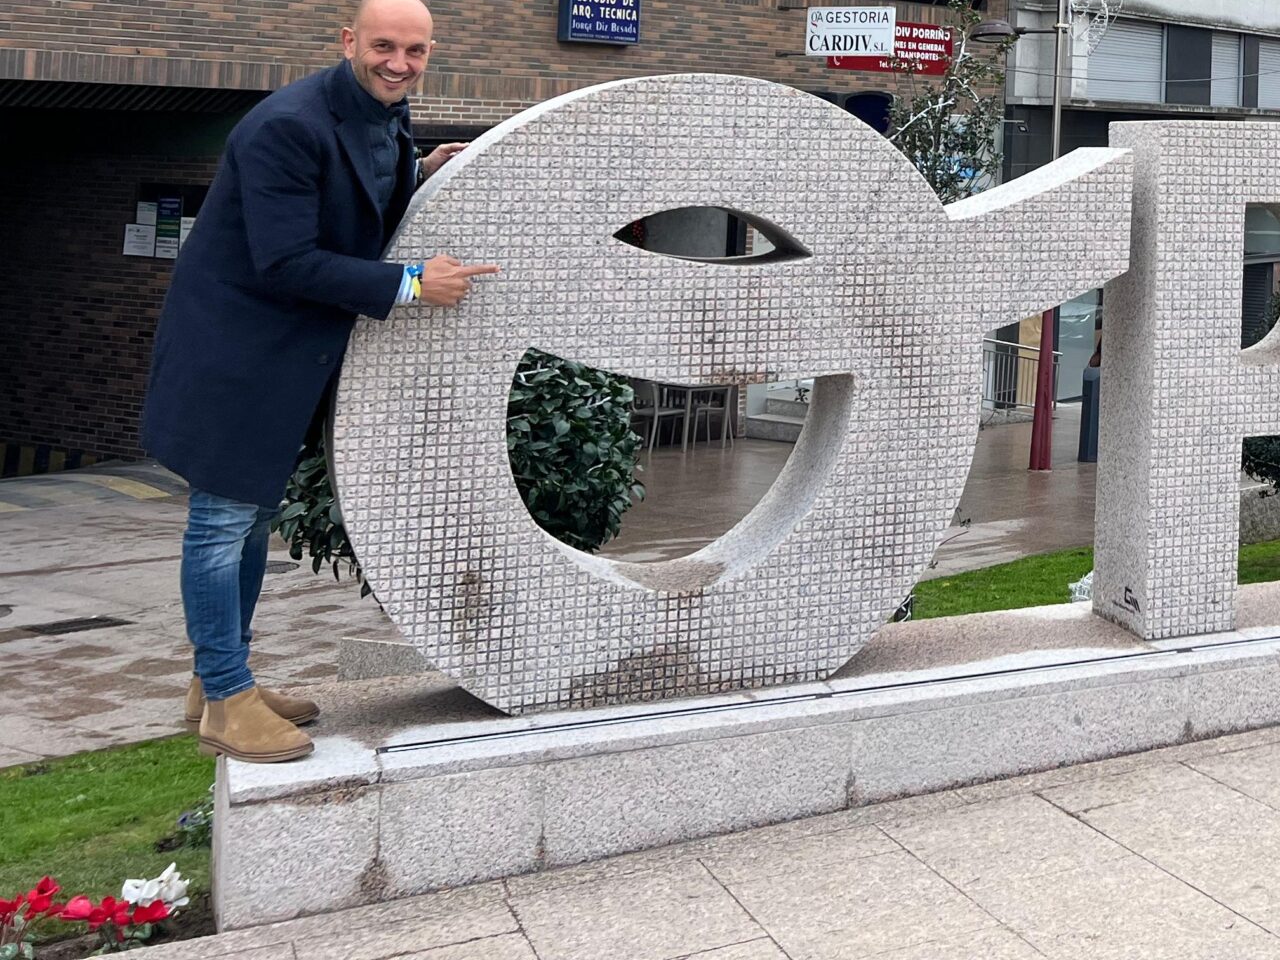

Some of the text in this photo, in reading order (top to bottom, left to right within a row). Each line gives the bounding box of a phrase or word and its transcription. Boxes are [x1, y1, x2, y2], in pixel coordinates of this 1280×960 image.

[572, 4, 638, 21] ARQ. TECNICA
[826, 11, 889, 24] GESTORIA
[895, 26, 911, 38] DIV
[908, 41, 917, 50] EN
[918, 42, 946, 52] GENERAL
